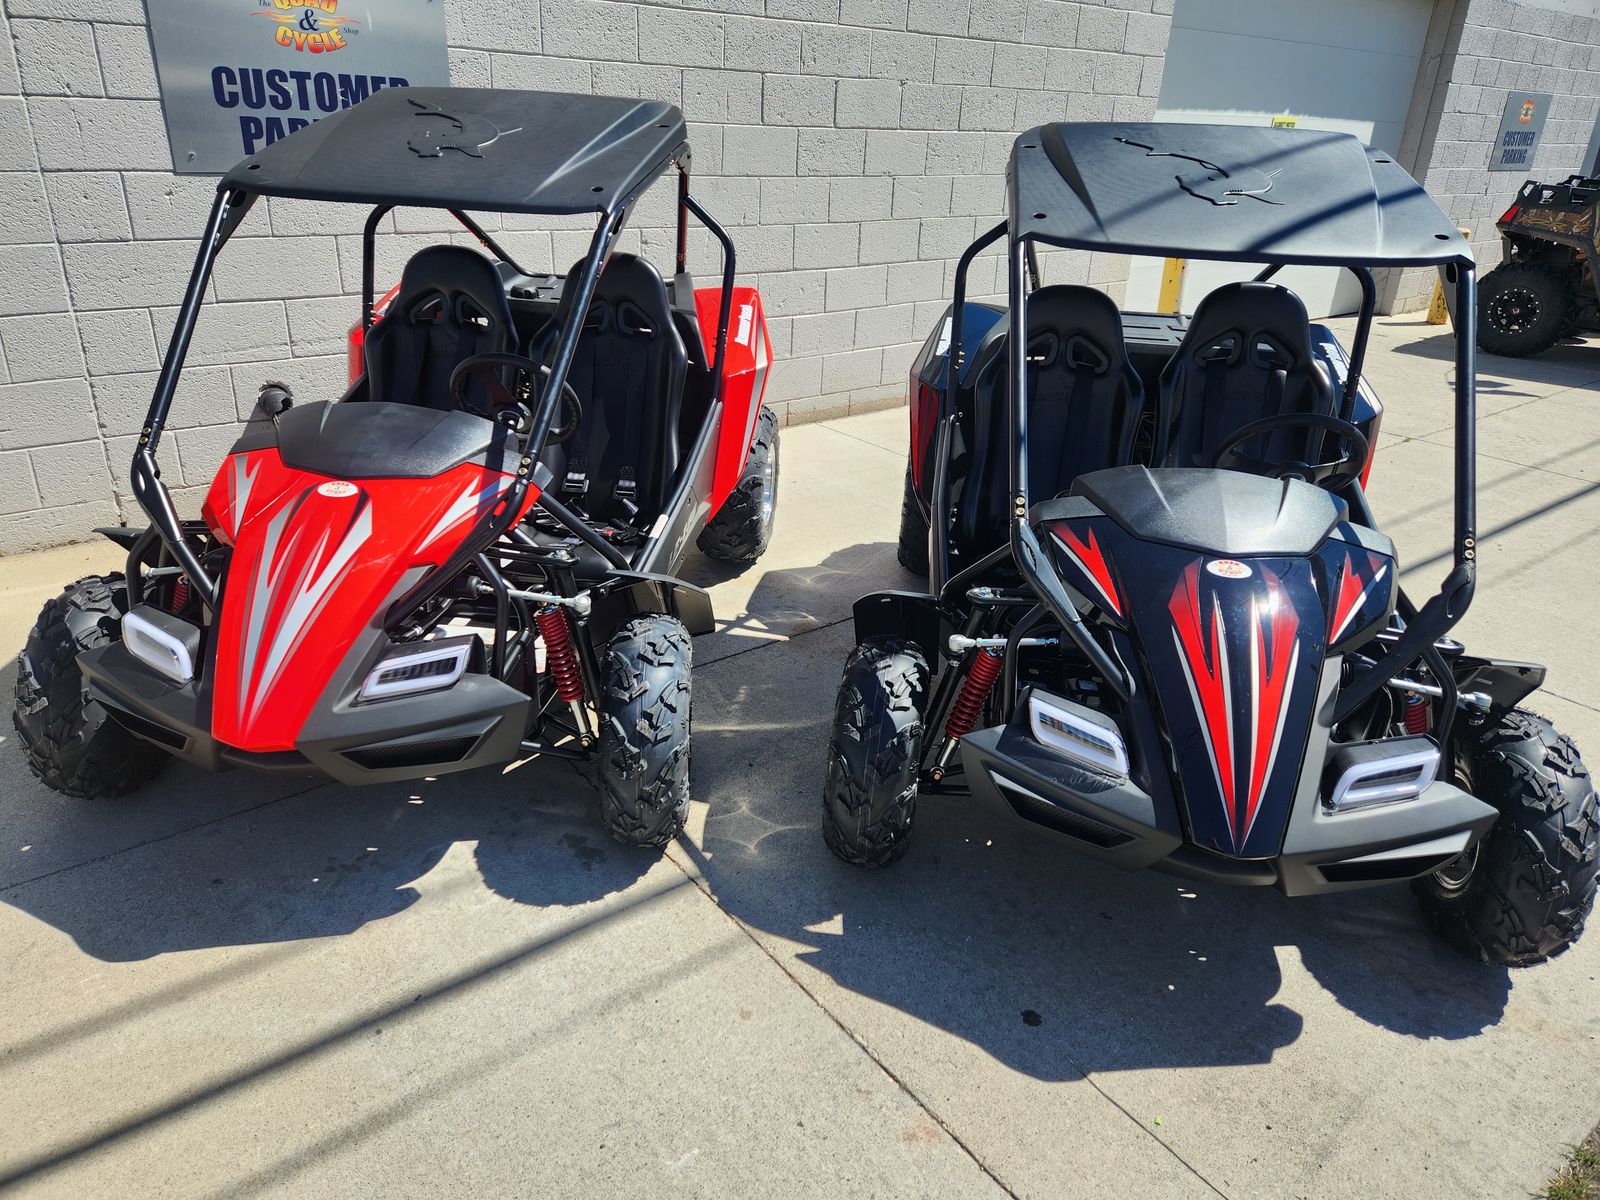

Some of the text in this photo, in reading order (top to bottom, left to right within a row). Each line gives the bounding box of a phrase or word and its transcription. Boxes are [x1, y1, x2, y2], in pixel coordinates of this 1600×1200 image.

[299, 9, 319, 31] &
[275, 25, 347, 54] CYCLE
[343, 27, 359, 36] Shop
[211, 66, 410, 113] CUSTOM
[1503, 131, 1535, 146] CUSTOMER
[1501, 149, 1527, 164] PARKING
